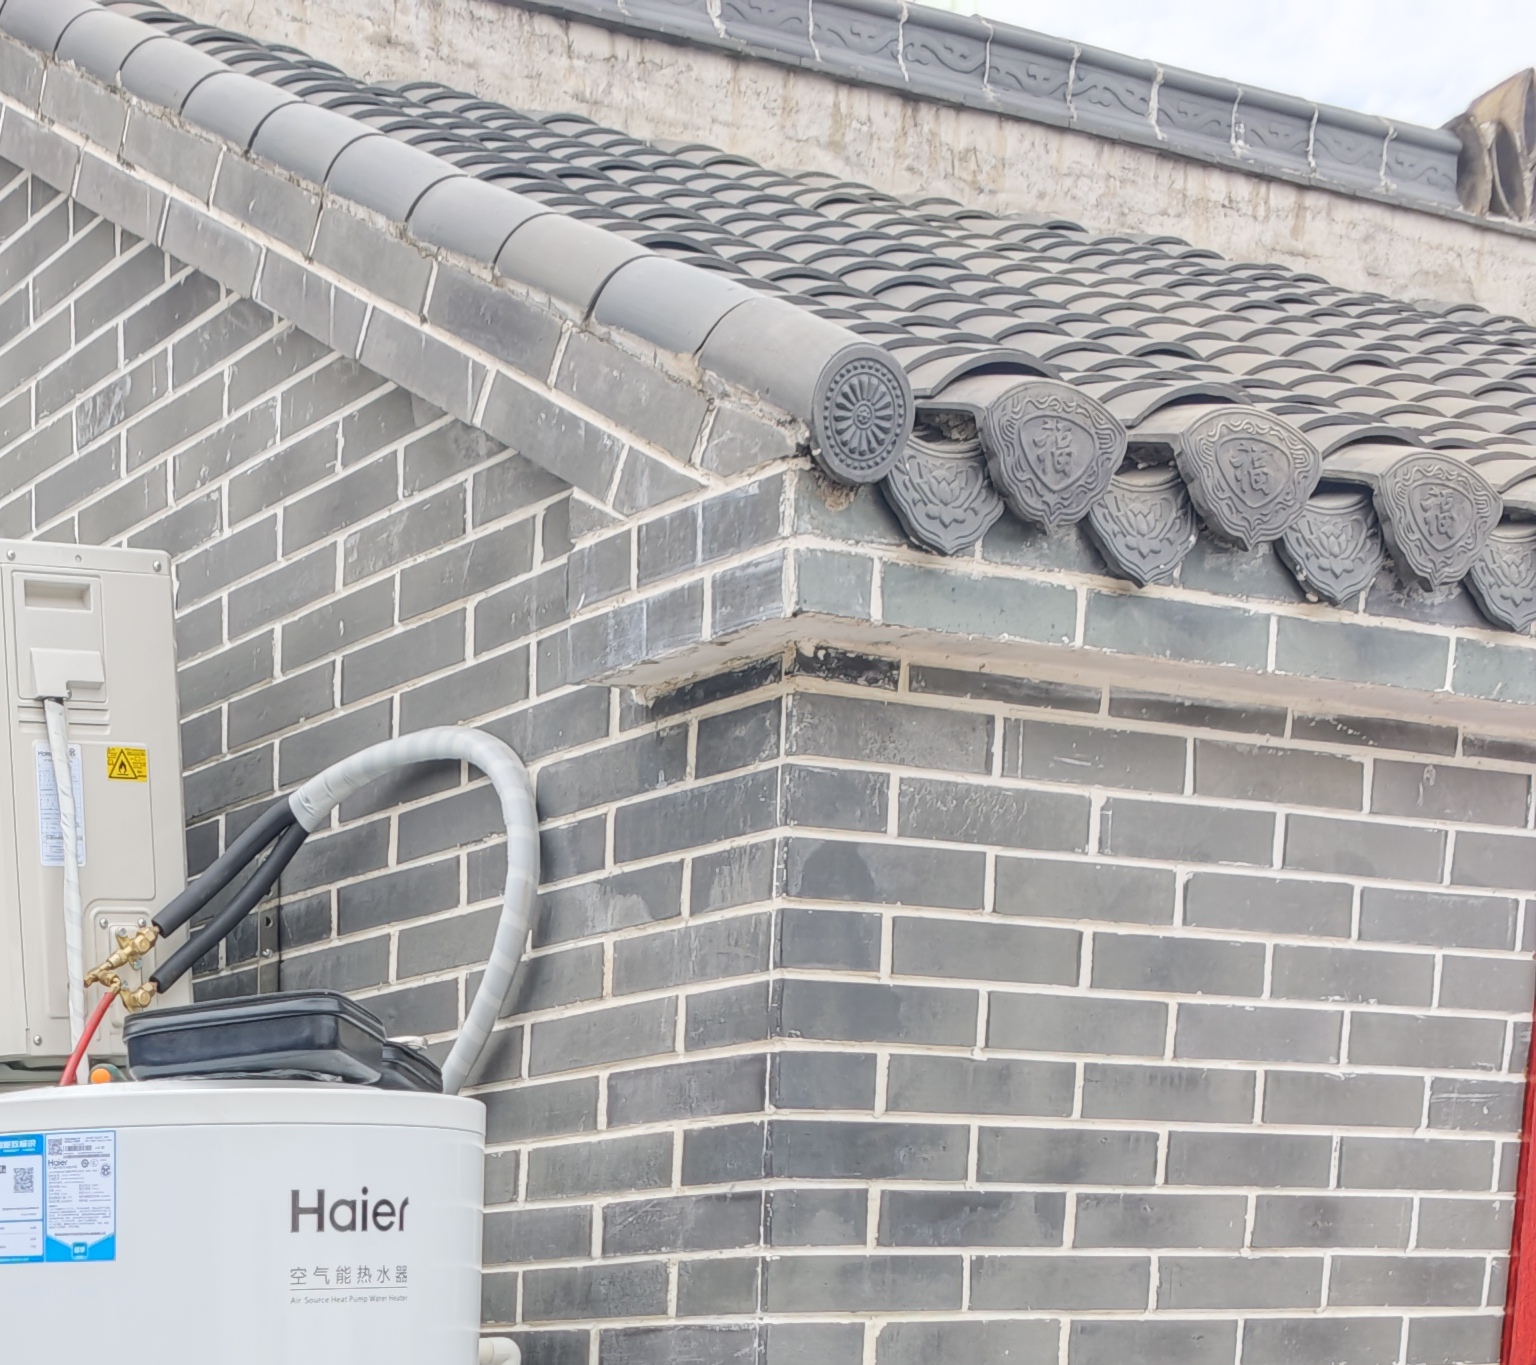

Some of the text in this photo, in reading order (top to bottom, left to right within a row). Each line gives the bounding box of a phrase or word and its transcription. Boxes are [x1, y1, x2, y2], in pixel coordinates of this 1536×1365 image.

[290, 1185, 409, 1233] Haier
[290, 1264, 408, 1286] 空气能热水器
